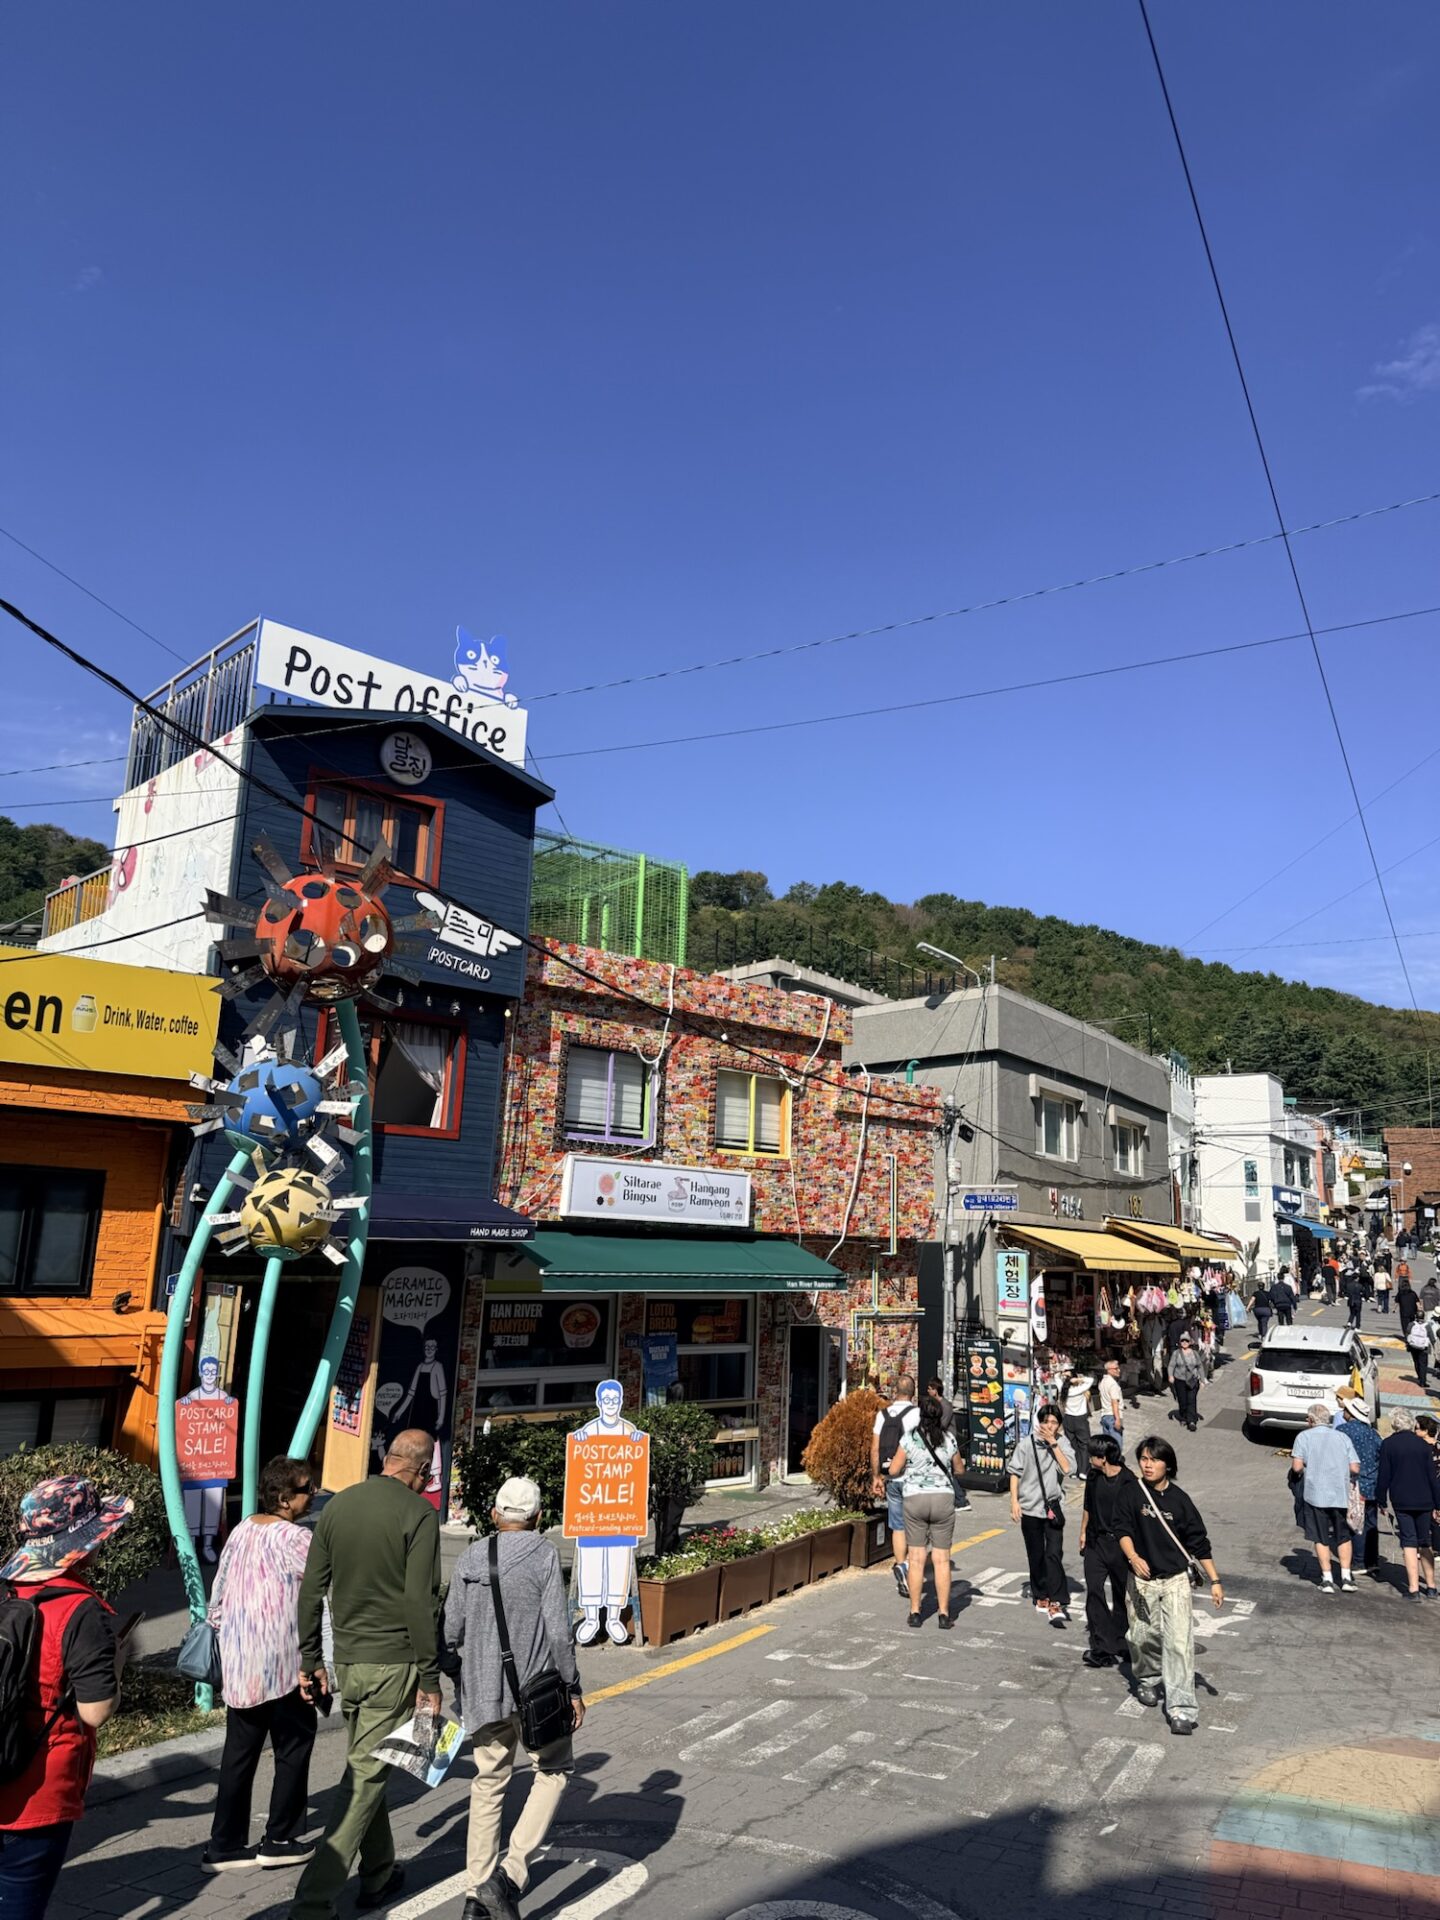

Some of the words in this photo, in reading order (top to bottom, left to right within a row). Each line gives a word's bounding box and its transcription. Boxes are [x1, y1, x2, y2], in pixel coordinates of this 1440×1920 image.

[285, 646, 382, 709] Post
[429, 947, 491, 980] POSTCARD
[104, 1005, 134, 1030] Drink,
[136, 1009, 167, 1034] Water,
[169, 1016, 199, 1036] coffee
[623, 1175, 662, 1190] Siltarae
[690, 1181, 730, 1197] Hangang
[623, 1189, 657, 1205] Bingsu
[689, 1194, 731, 1210] Ramyeon
[470, 1227, 490, 1237] HAND
[491, 1228, 510, 1237] MADE
[511, 1228, 528, 1238] SHOP
[386, 1276, 443, 1291] CERAMIC
[786, 1280, 798, 1288] Han
[1004, 1254, 1021, 1299] 체험장
[385, 1291, 443, 1308] MAGNET
[490, 1303, 512, 1319] HAN
[513, 1303, 544, 1318] RIVER
[649, 1303, 675, 1317] LOTTO
[489, 1318, 537, 1334] RAMYEON
[649, 1317, 677, 1330] BREAD
[180, 1407, 235, 1420] POSTCARD
[188, 1421, 226, 1435] STAMP
[184, 1435, 227, 1456] SALE!
[573, 1444, 644, 1460] POSTCARD
[584, 1463, 633, 1480] STAMP
[580, 1481, 635, 1506] SALE!
[574, 1511, 596, 1524] 엽서를
[568, 1524, 621, 1534] Postcard-sending
